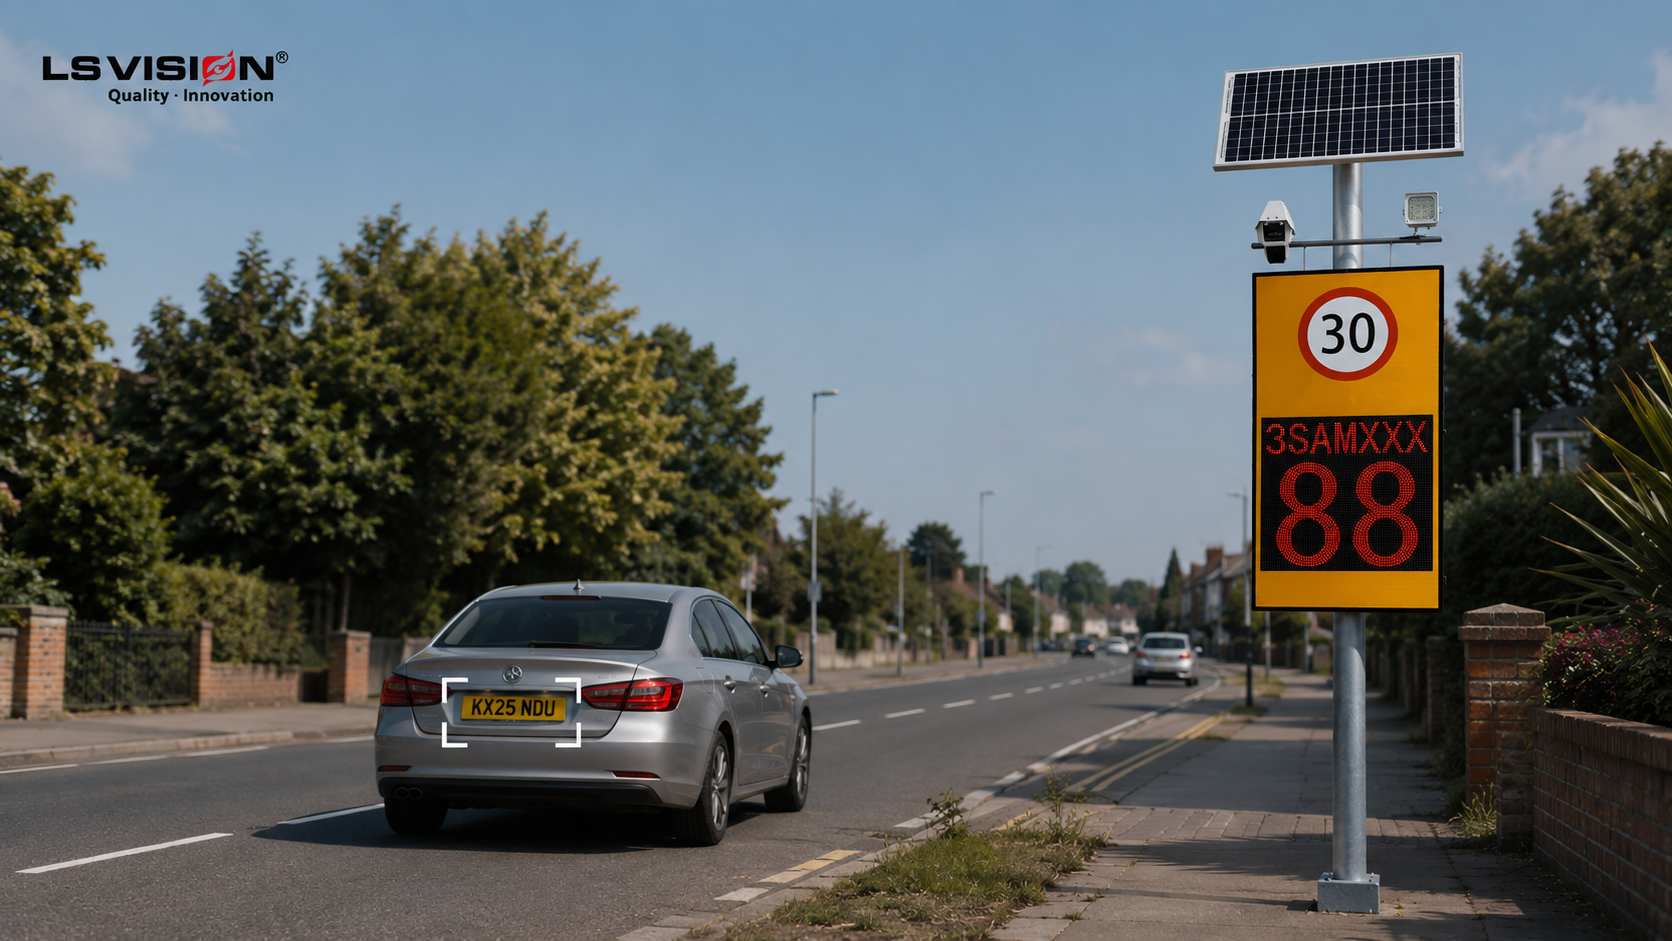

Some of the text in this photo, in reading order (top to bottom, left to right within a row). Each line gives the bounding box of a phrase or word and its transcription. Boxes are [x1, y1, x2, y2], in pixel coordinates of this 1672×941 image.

[1320, 312, 1376, 355] 30
[1266, 420, 1428, 455] 3SAMXXX
[1275, 460, 1419, 567] 88
[471, 698, 556, 717] KX25 NDU
